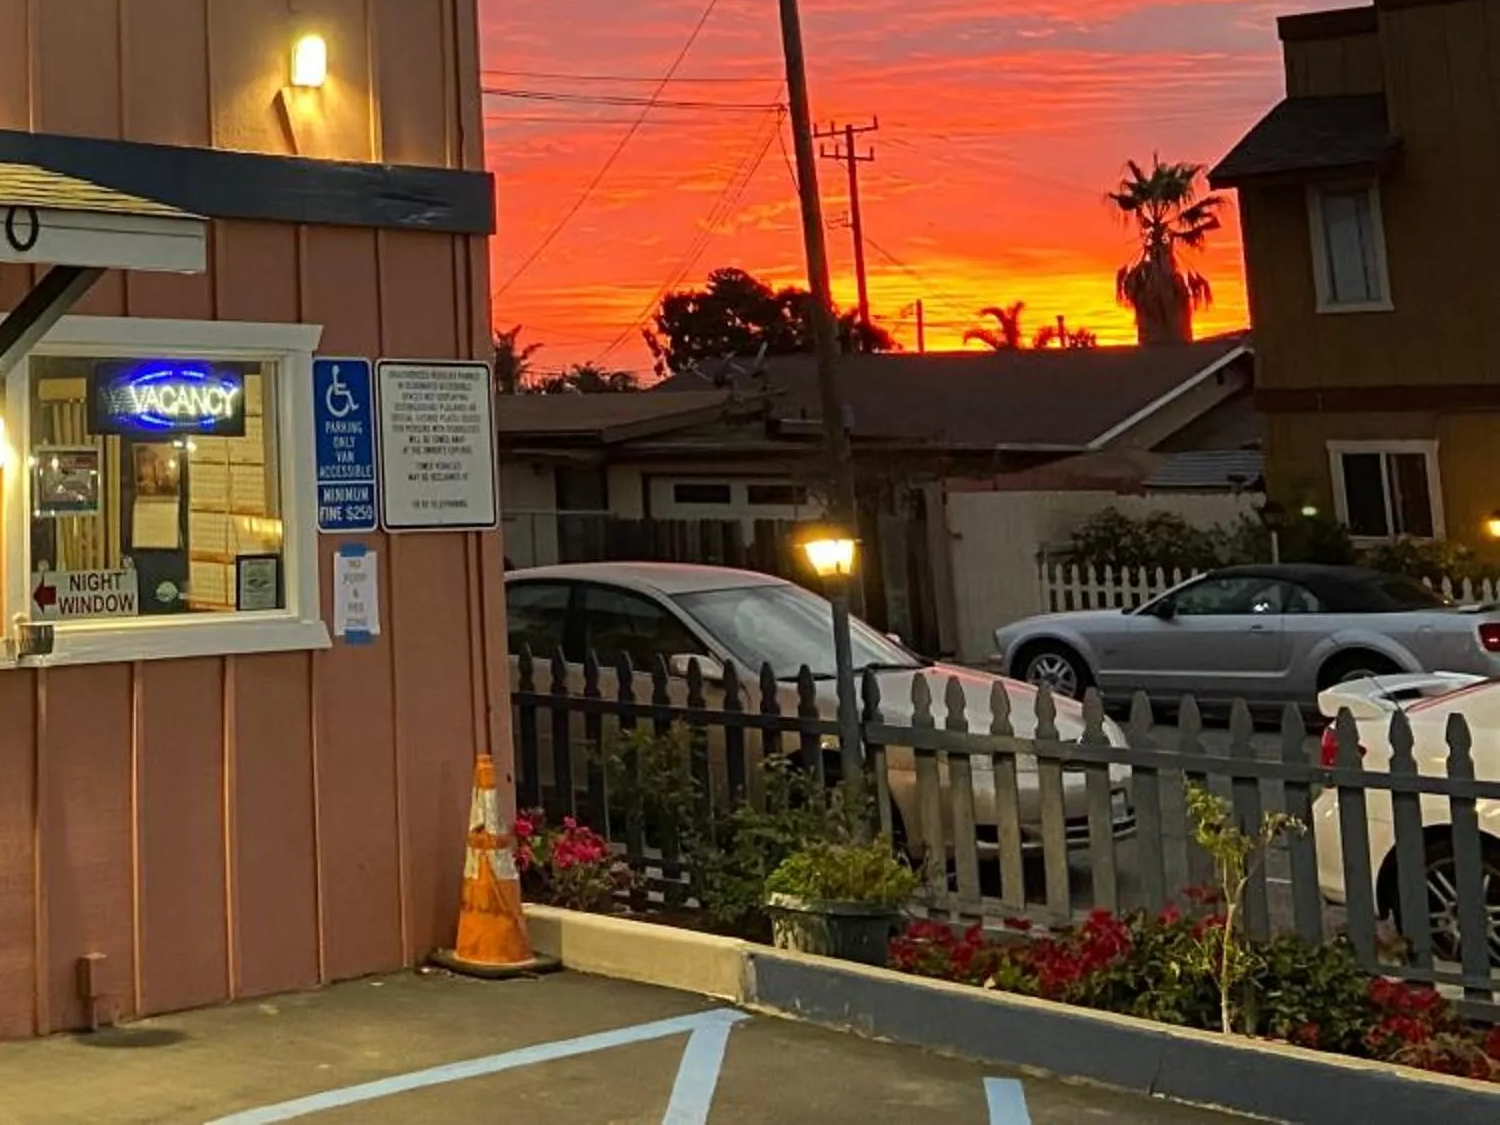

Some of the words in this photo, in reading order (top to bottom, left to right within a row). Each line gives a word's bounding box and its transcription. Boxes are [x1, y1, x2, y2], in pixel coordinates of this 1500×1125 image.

[129, 383, 239, 418] VACANCY
[325, 420, 363, 434] PARKING
[333, 435, 356, 448] ONLY
[335, 450, 355, 463] VAN
[320, 463, 373, 478] ACCESSIBLE
[323, 486, 370, 503] MINIMUM
[320, 505, 343, 523] FINE
[346, 503, 373, 522] $250
[69, 570, 125, 592] NIGHT
[58, 591, 135, 616] WINDOW
